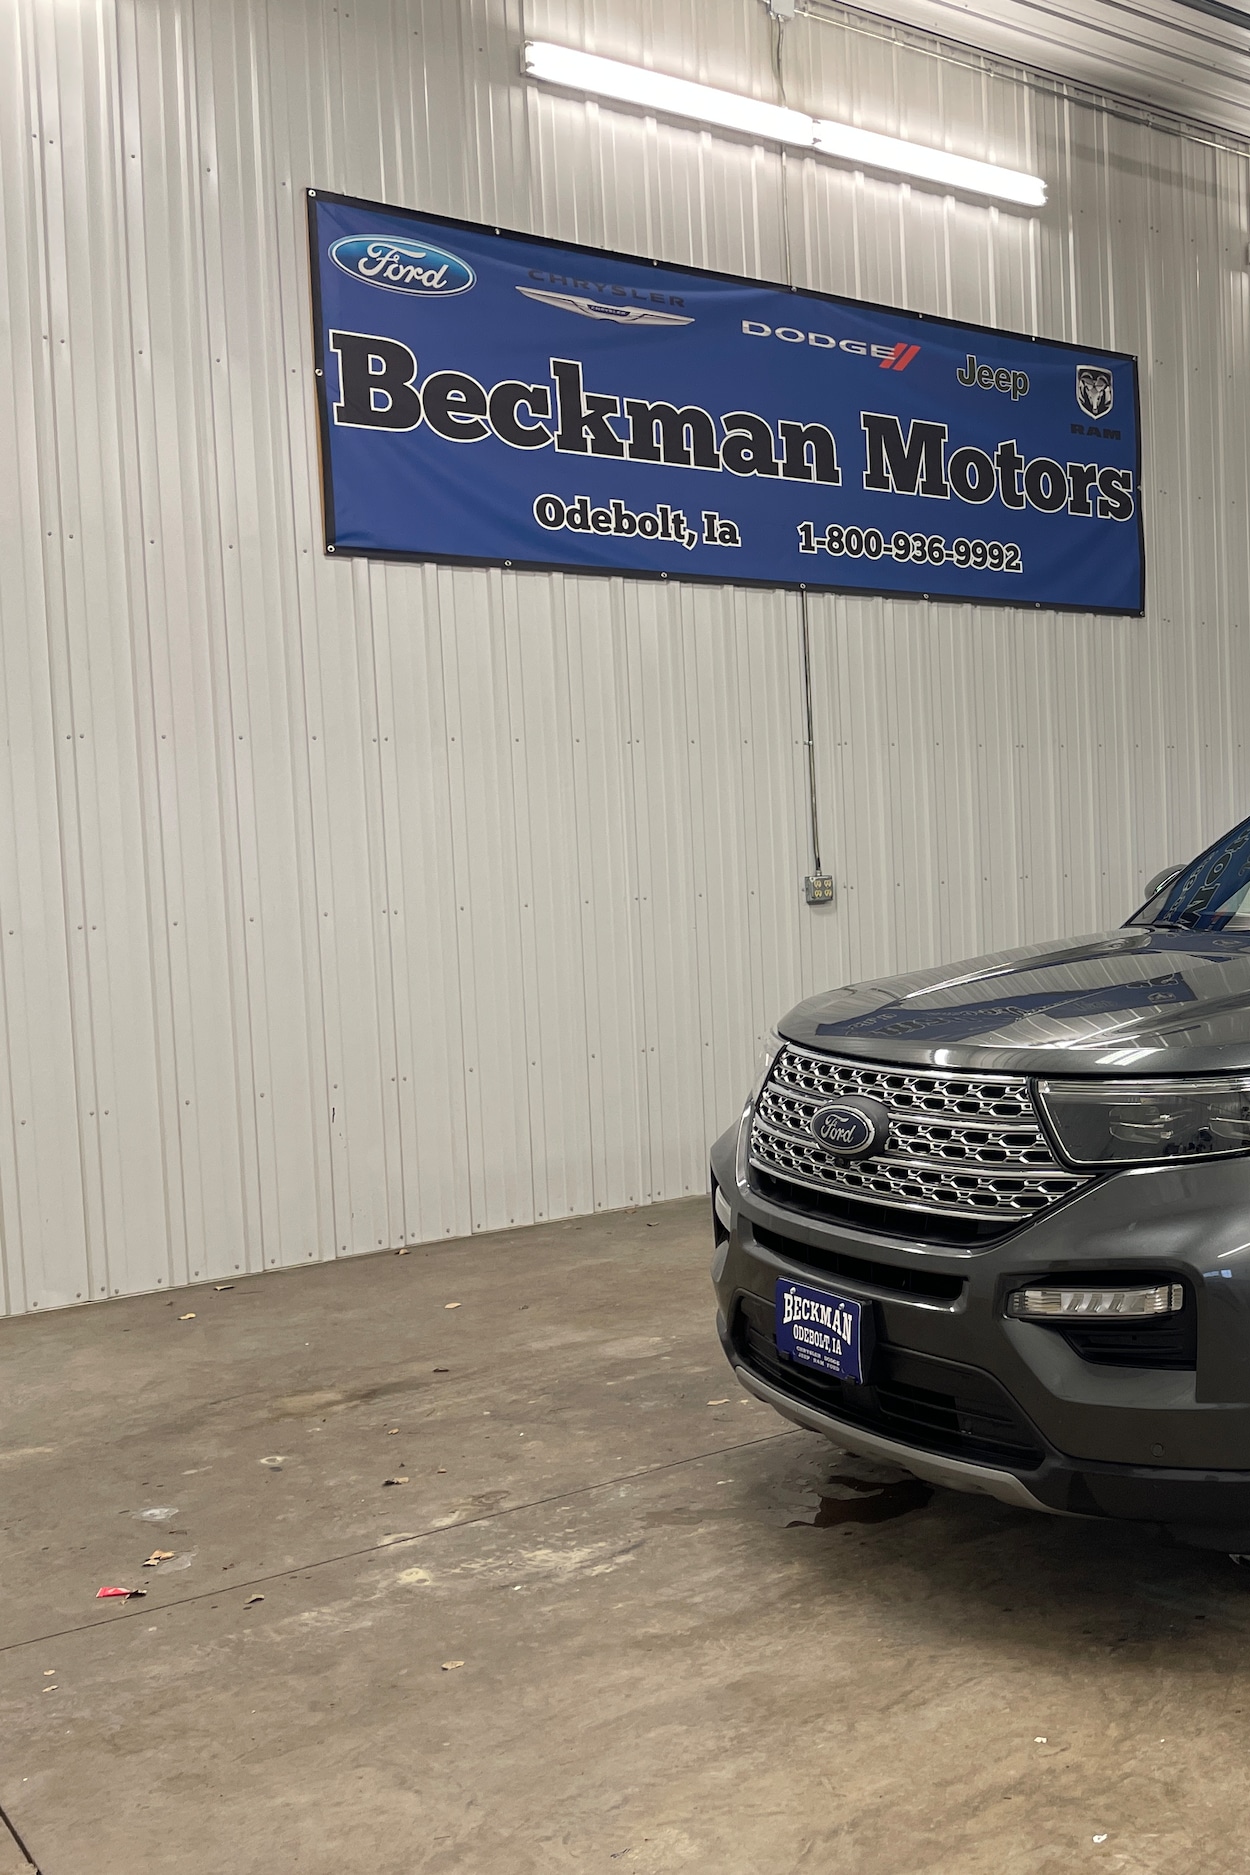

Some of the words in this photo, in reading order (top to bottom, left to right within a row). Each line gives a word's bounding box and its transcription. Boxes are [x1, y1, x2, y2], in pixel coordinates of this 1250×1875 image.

[357, 242, 450, 290] Ford
[528, 269, 685, 308] CHRYSLER
[741, 319, 897, 361] DODGE
[957, 354, 1030, 401] Jeep
[328, 328, 842, 487] Beckman
[860, 410, 1135, 521] Motors
[1070, 423, 1121, 441] RAM
[533, 493, 699, 550] Odebolt,
[702, 511, 742, 548] Ia
[796, 521, 1024, 574] 1-800-936-9992
[820, 1113, 857, 1144] Ford
[783, 1292, 853, 1346] BECKMAN
[793, 1323, 831, 1354] ODEBOLT,
[832, 1337, 842, 1356] IA
